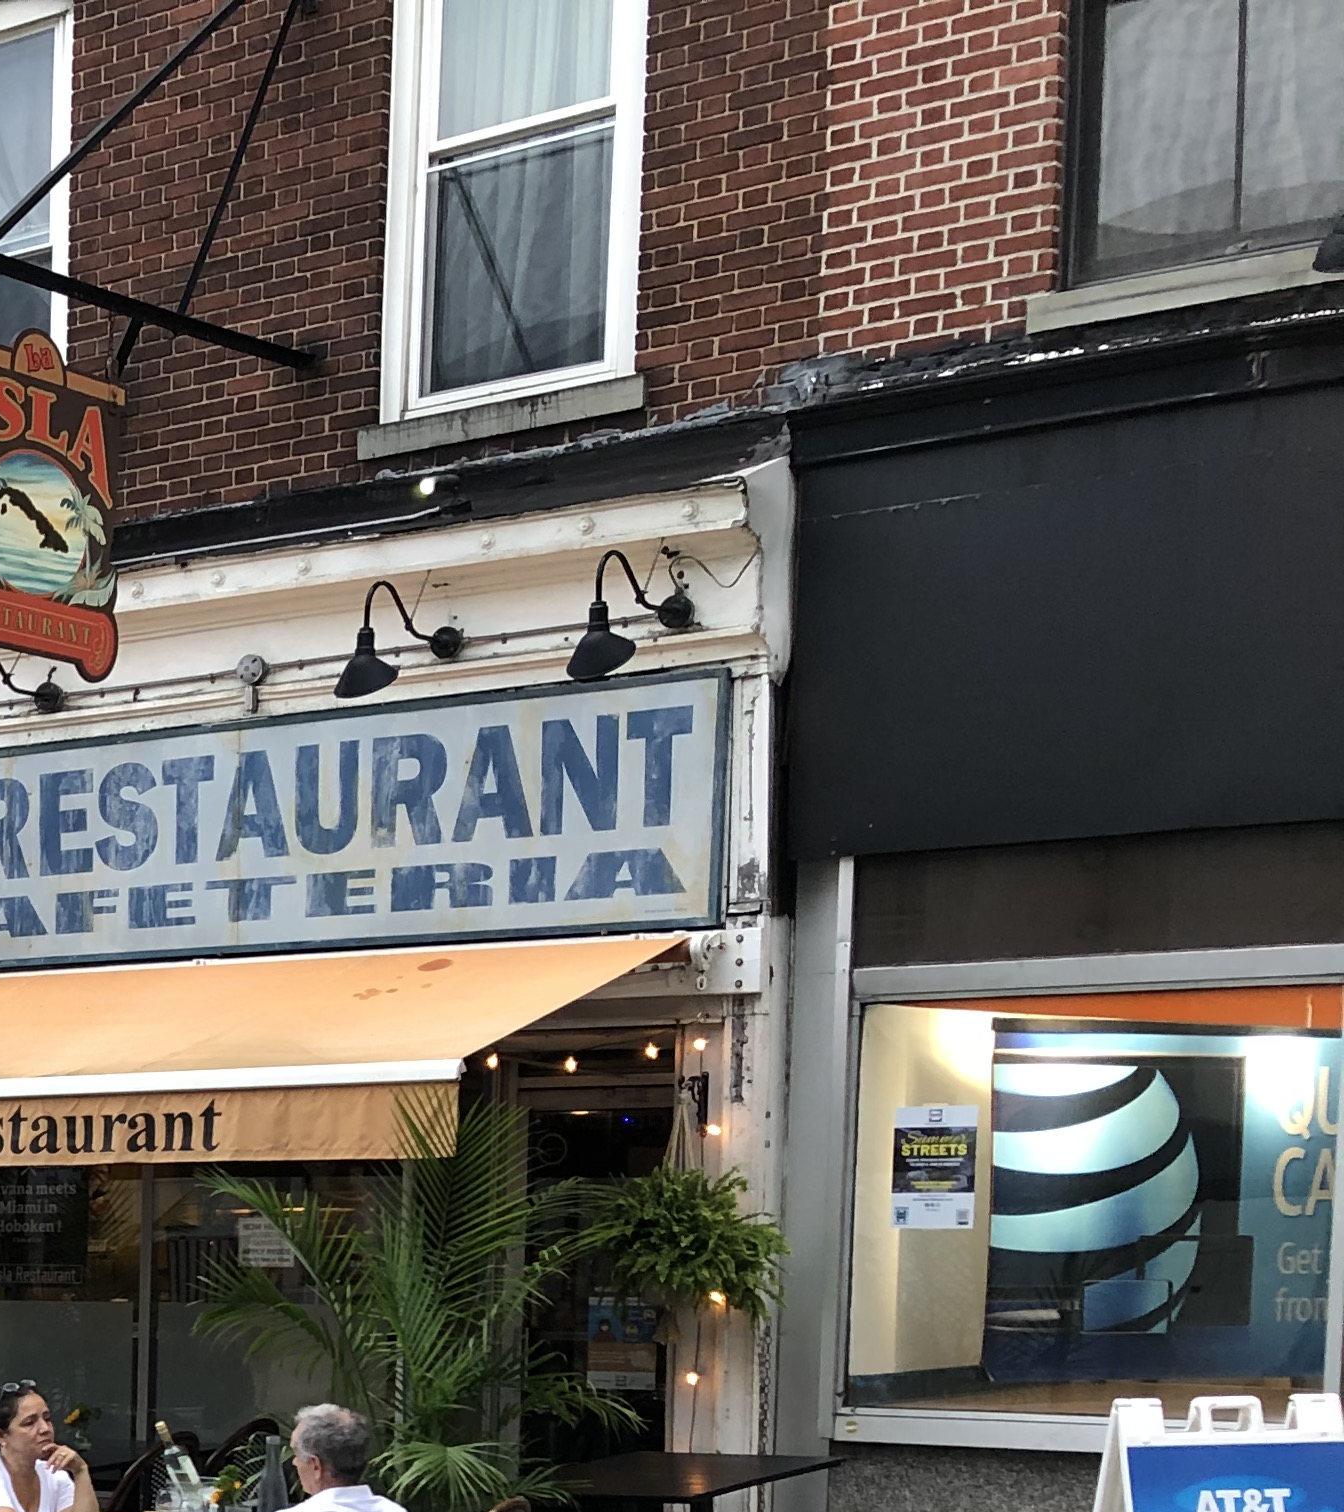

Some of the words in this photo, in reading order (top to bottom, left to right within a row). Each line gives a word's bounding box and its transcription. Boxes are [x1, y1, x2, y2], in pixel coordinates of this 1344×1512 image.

[23, 343, 54, 372] La
[901, 1143, 968, 1157] STREETS
[35, 1182, 77, 1195] meets
[1272, 1146, 1335, 1218] CA
[44, 1200, 58, 1214] in
[1276, 1241, 1323, 1275] Get
[15, 1266, 76, 1281] Restaurant
